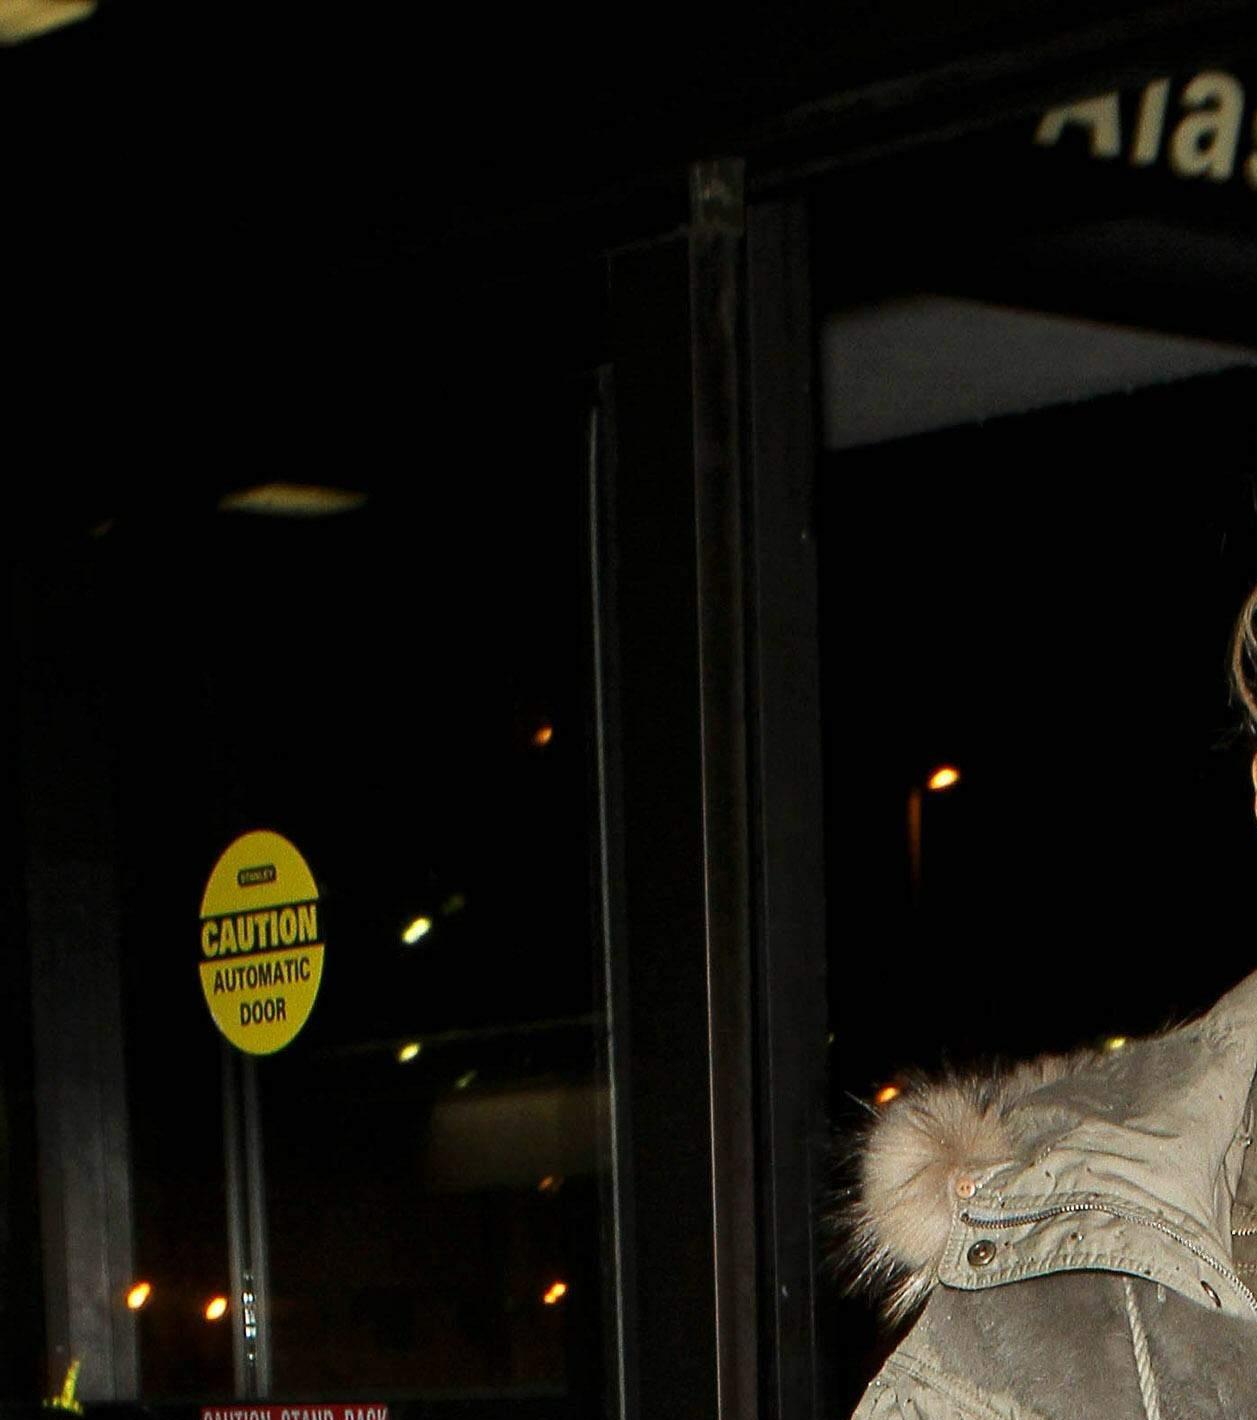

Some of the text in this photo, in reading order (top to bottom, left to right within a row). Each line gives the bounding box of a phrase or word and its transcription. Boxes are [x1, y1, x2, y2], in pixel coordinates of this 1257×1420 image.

[201, 904, 318, 958] CAUTION
[213, 956, 311, 995] AUTOMATIC
[239, 999, 287, 1026] DOOR
